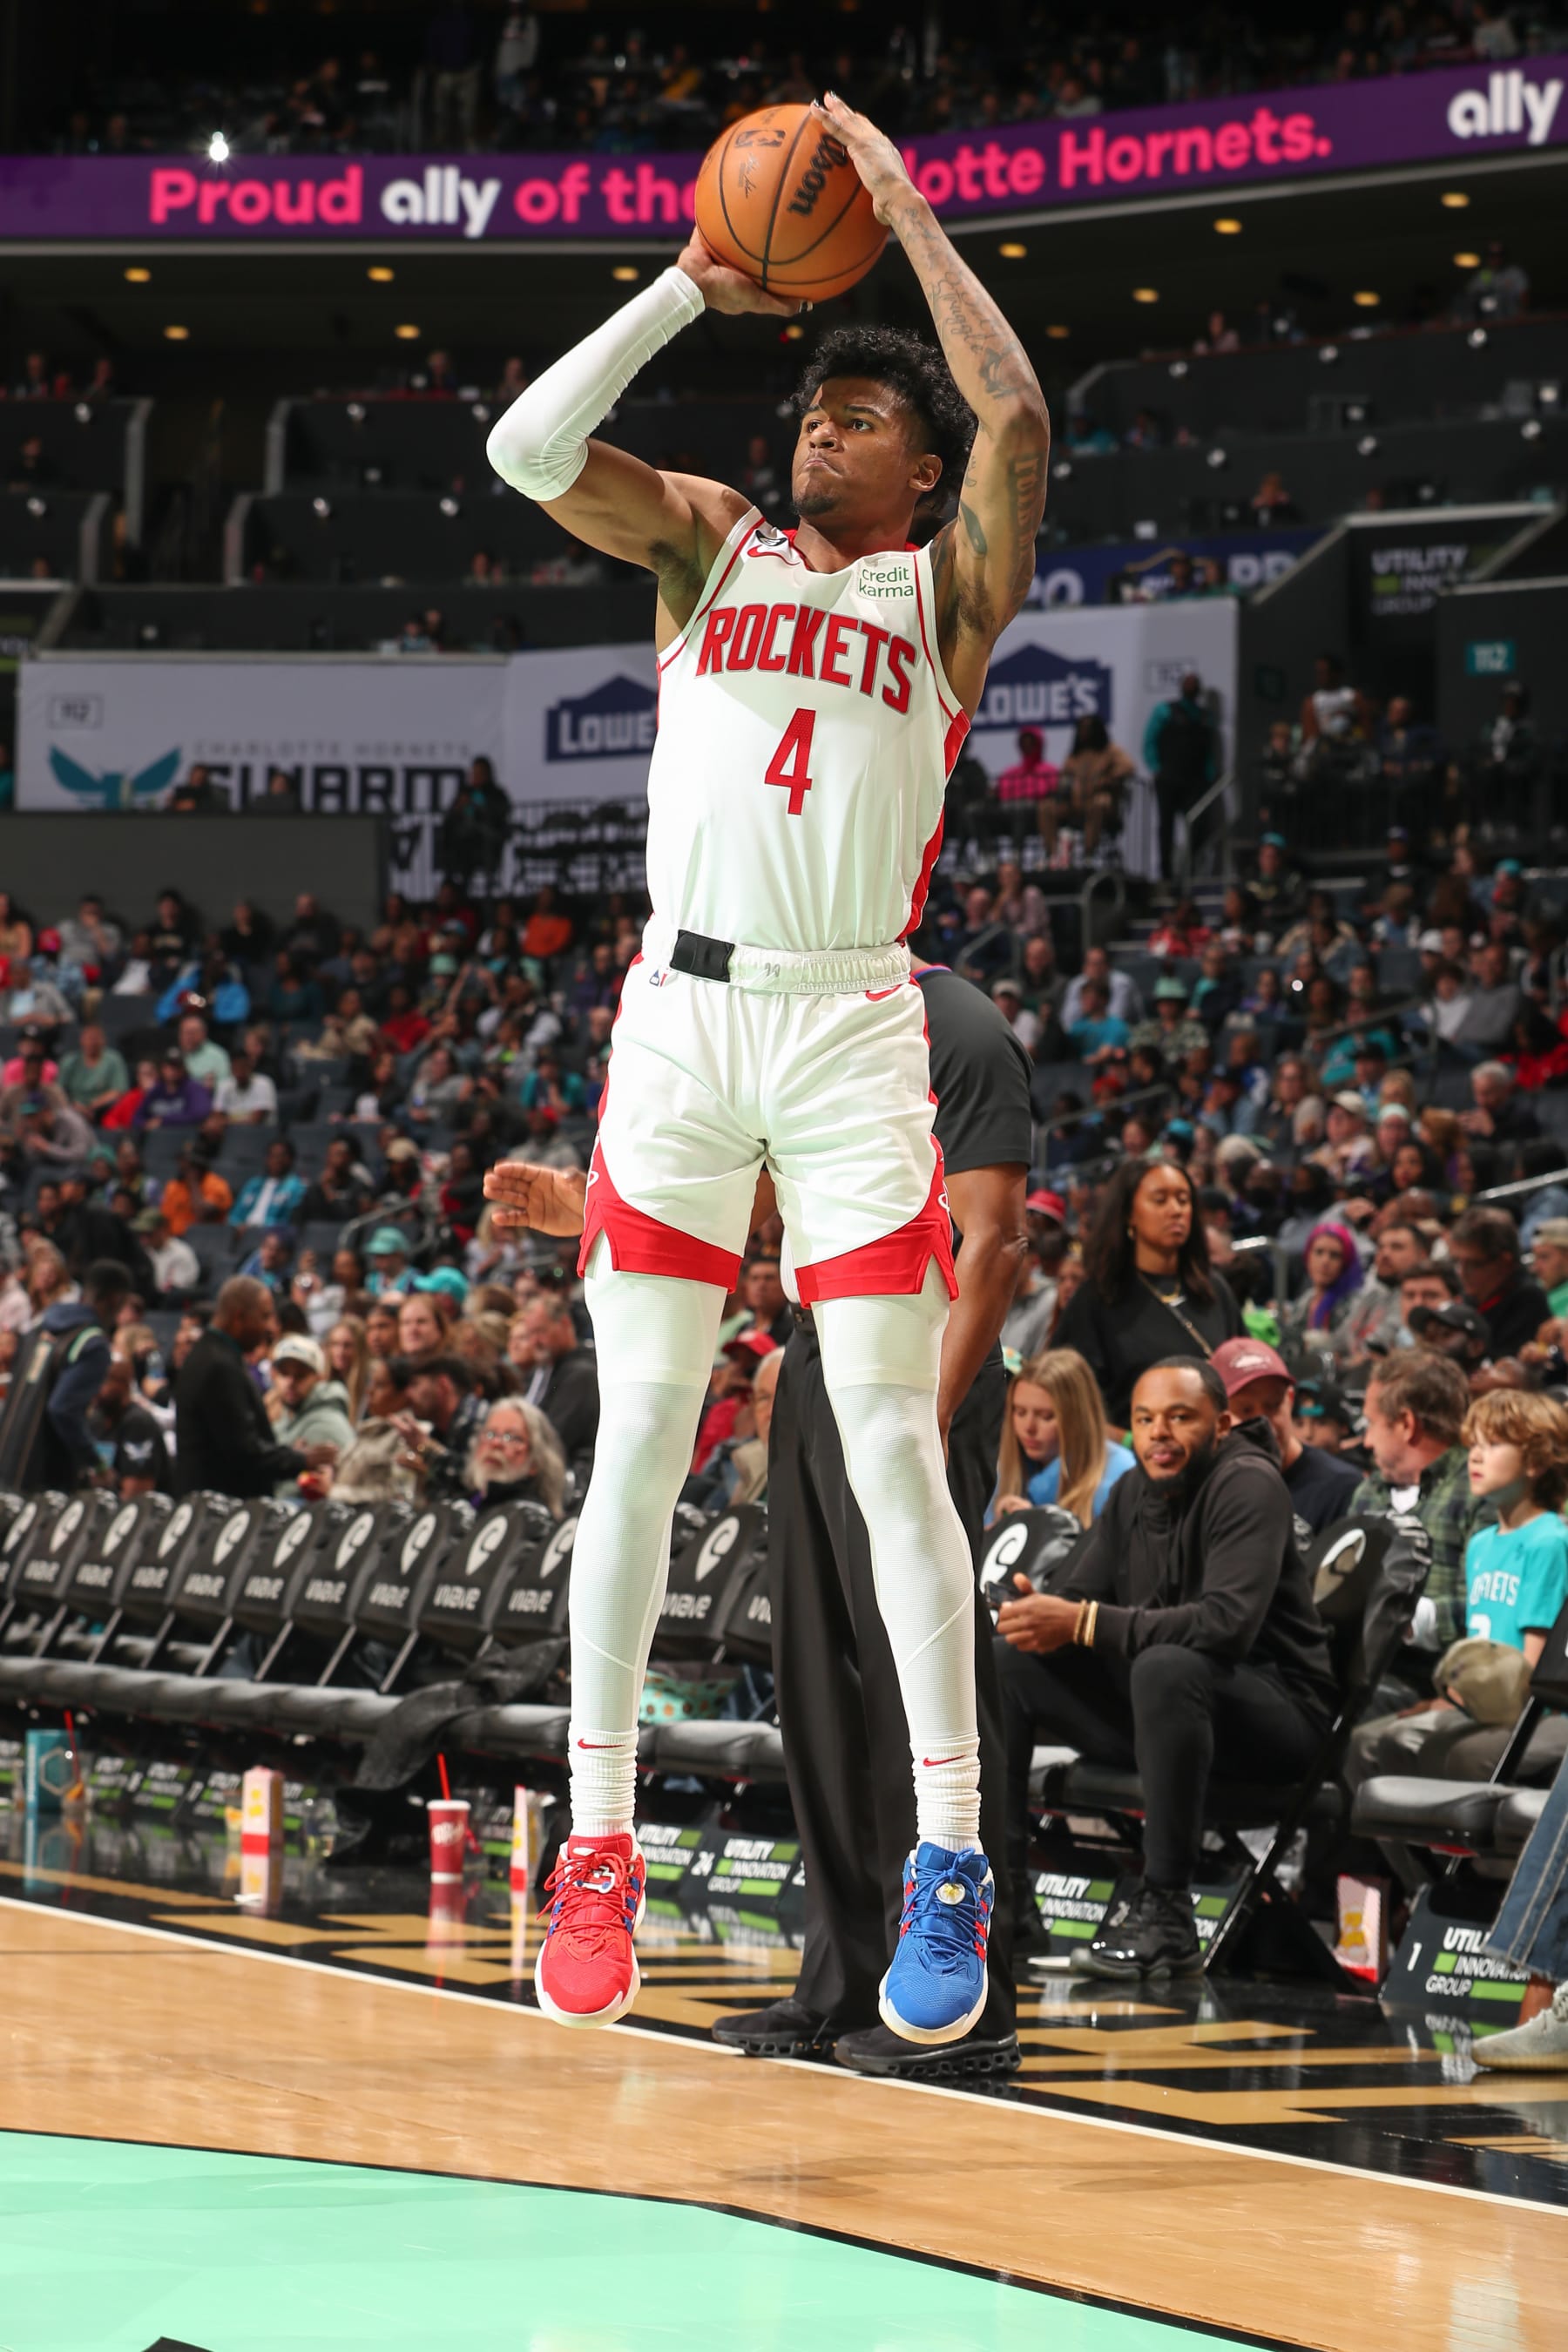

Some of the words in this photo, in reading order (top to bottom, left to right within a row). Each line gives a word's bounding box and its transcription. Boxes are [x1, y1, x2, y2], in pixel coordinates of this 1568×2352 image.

[1447, 69, 1564, 145] ally
[149, 163, 363, 225] Proud
[380, 165, 502, 239] ally
[513, 162, 591, 224] of
[1059, 106, 1333, 189] Hornets.
[1371, 544, 1469, 574] UTILITY
[859, 578, 915, 598] karma
[862, 566, 910, 584] credit
[694, 602, 917, 716] ROCKETS
[765, 708, 816, 815] 4
[637, 1823, 682, 1846] UTILITY
[724, 1838, 775, 1861] UTILITY
[691, 1850, 715, 1876] 24
[730, 1860, 791, 1880] INNOVATION
[707, 1876, 741, 1894] GROUP
[1035, 1872, 1091, 1900] UTILITY
[1040, 1897, 1108, 1923] INNOVATION
[1407, 1942, 1423, 1972] 1
[1425, 1975, 1472, 1997] GROUP
